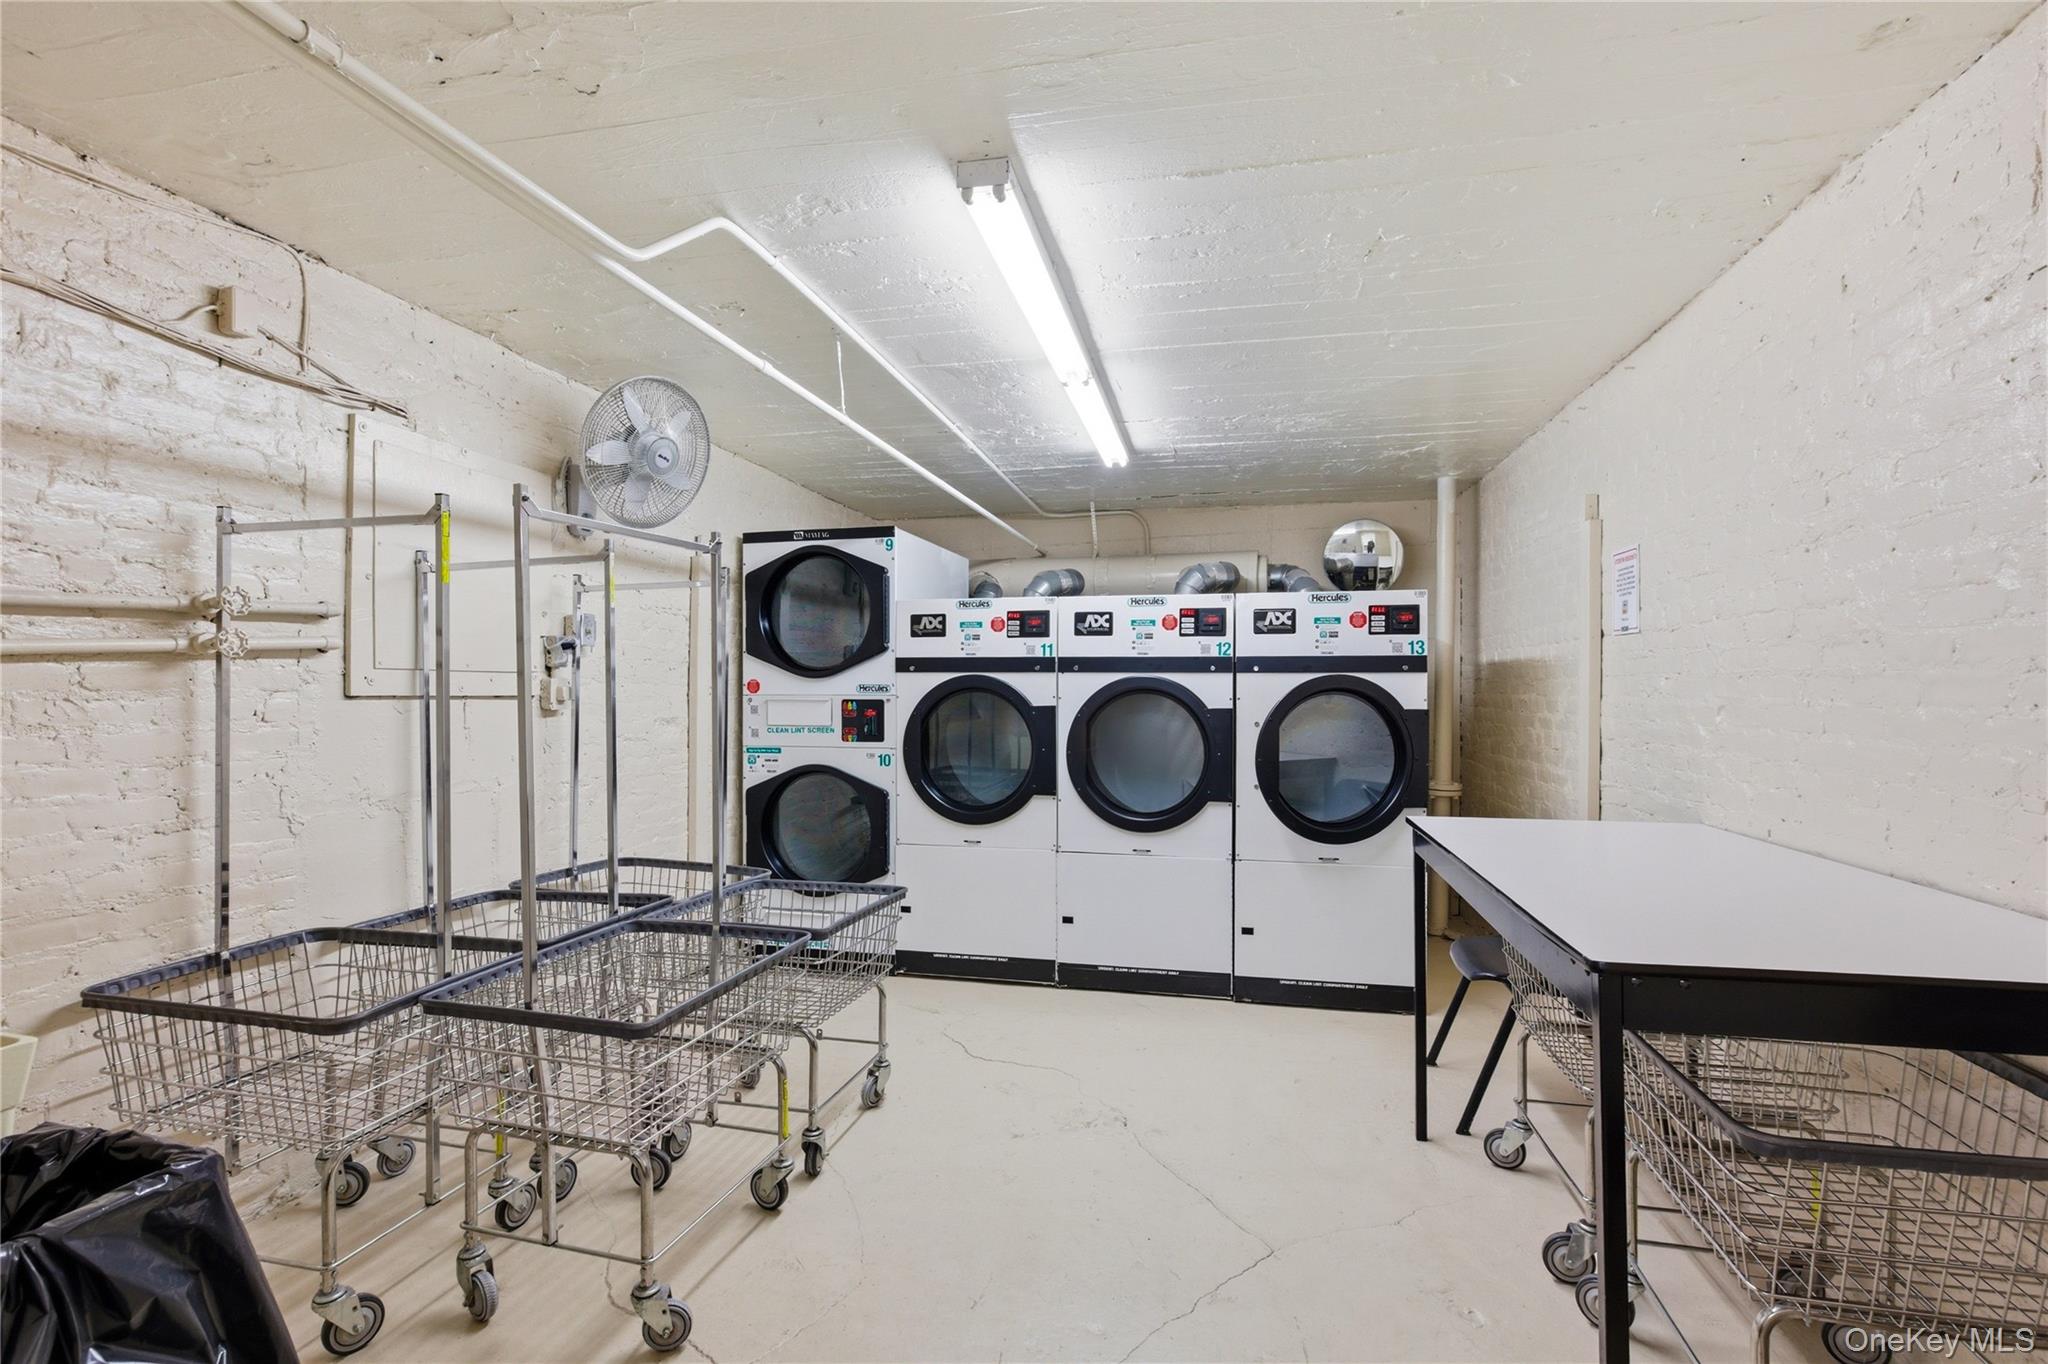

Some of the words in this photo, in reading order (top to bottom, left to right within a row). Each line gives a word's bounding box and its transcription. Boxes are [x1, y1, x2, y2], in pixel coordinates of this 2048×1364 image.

[885, 538, 894, 551] 9
[958, 600, 990, 608] Hercules
[1130, 597, 1165, 606] Hercules
[1311, 593, 1349, 602] Hercules
[919, 616, 943, 629] ADC
[1084, 614, 1110, 627] ADC
[1264, 611, 1293, 625] ADC
[1040, 643, 1053, 656] 11
[1216, 642, 1231, 656] 12
[1407, 640, 1425, 655] 13
[858, 684, 889, 692] Hercules
[877, 754, 891, 767] 10
